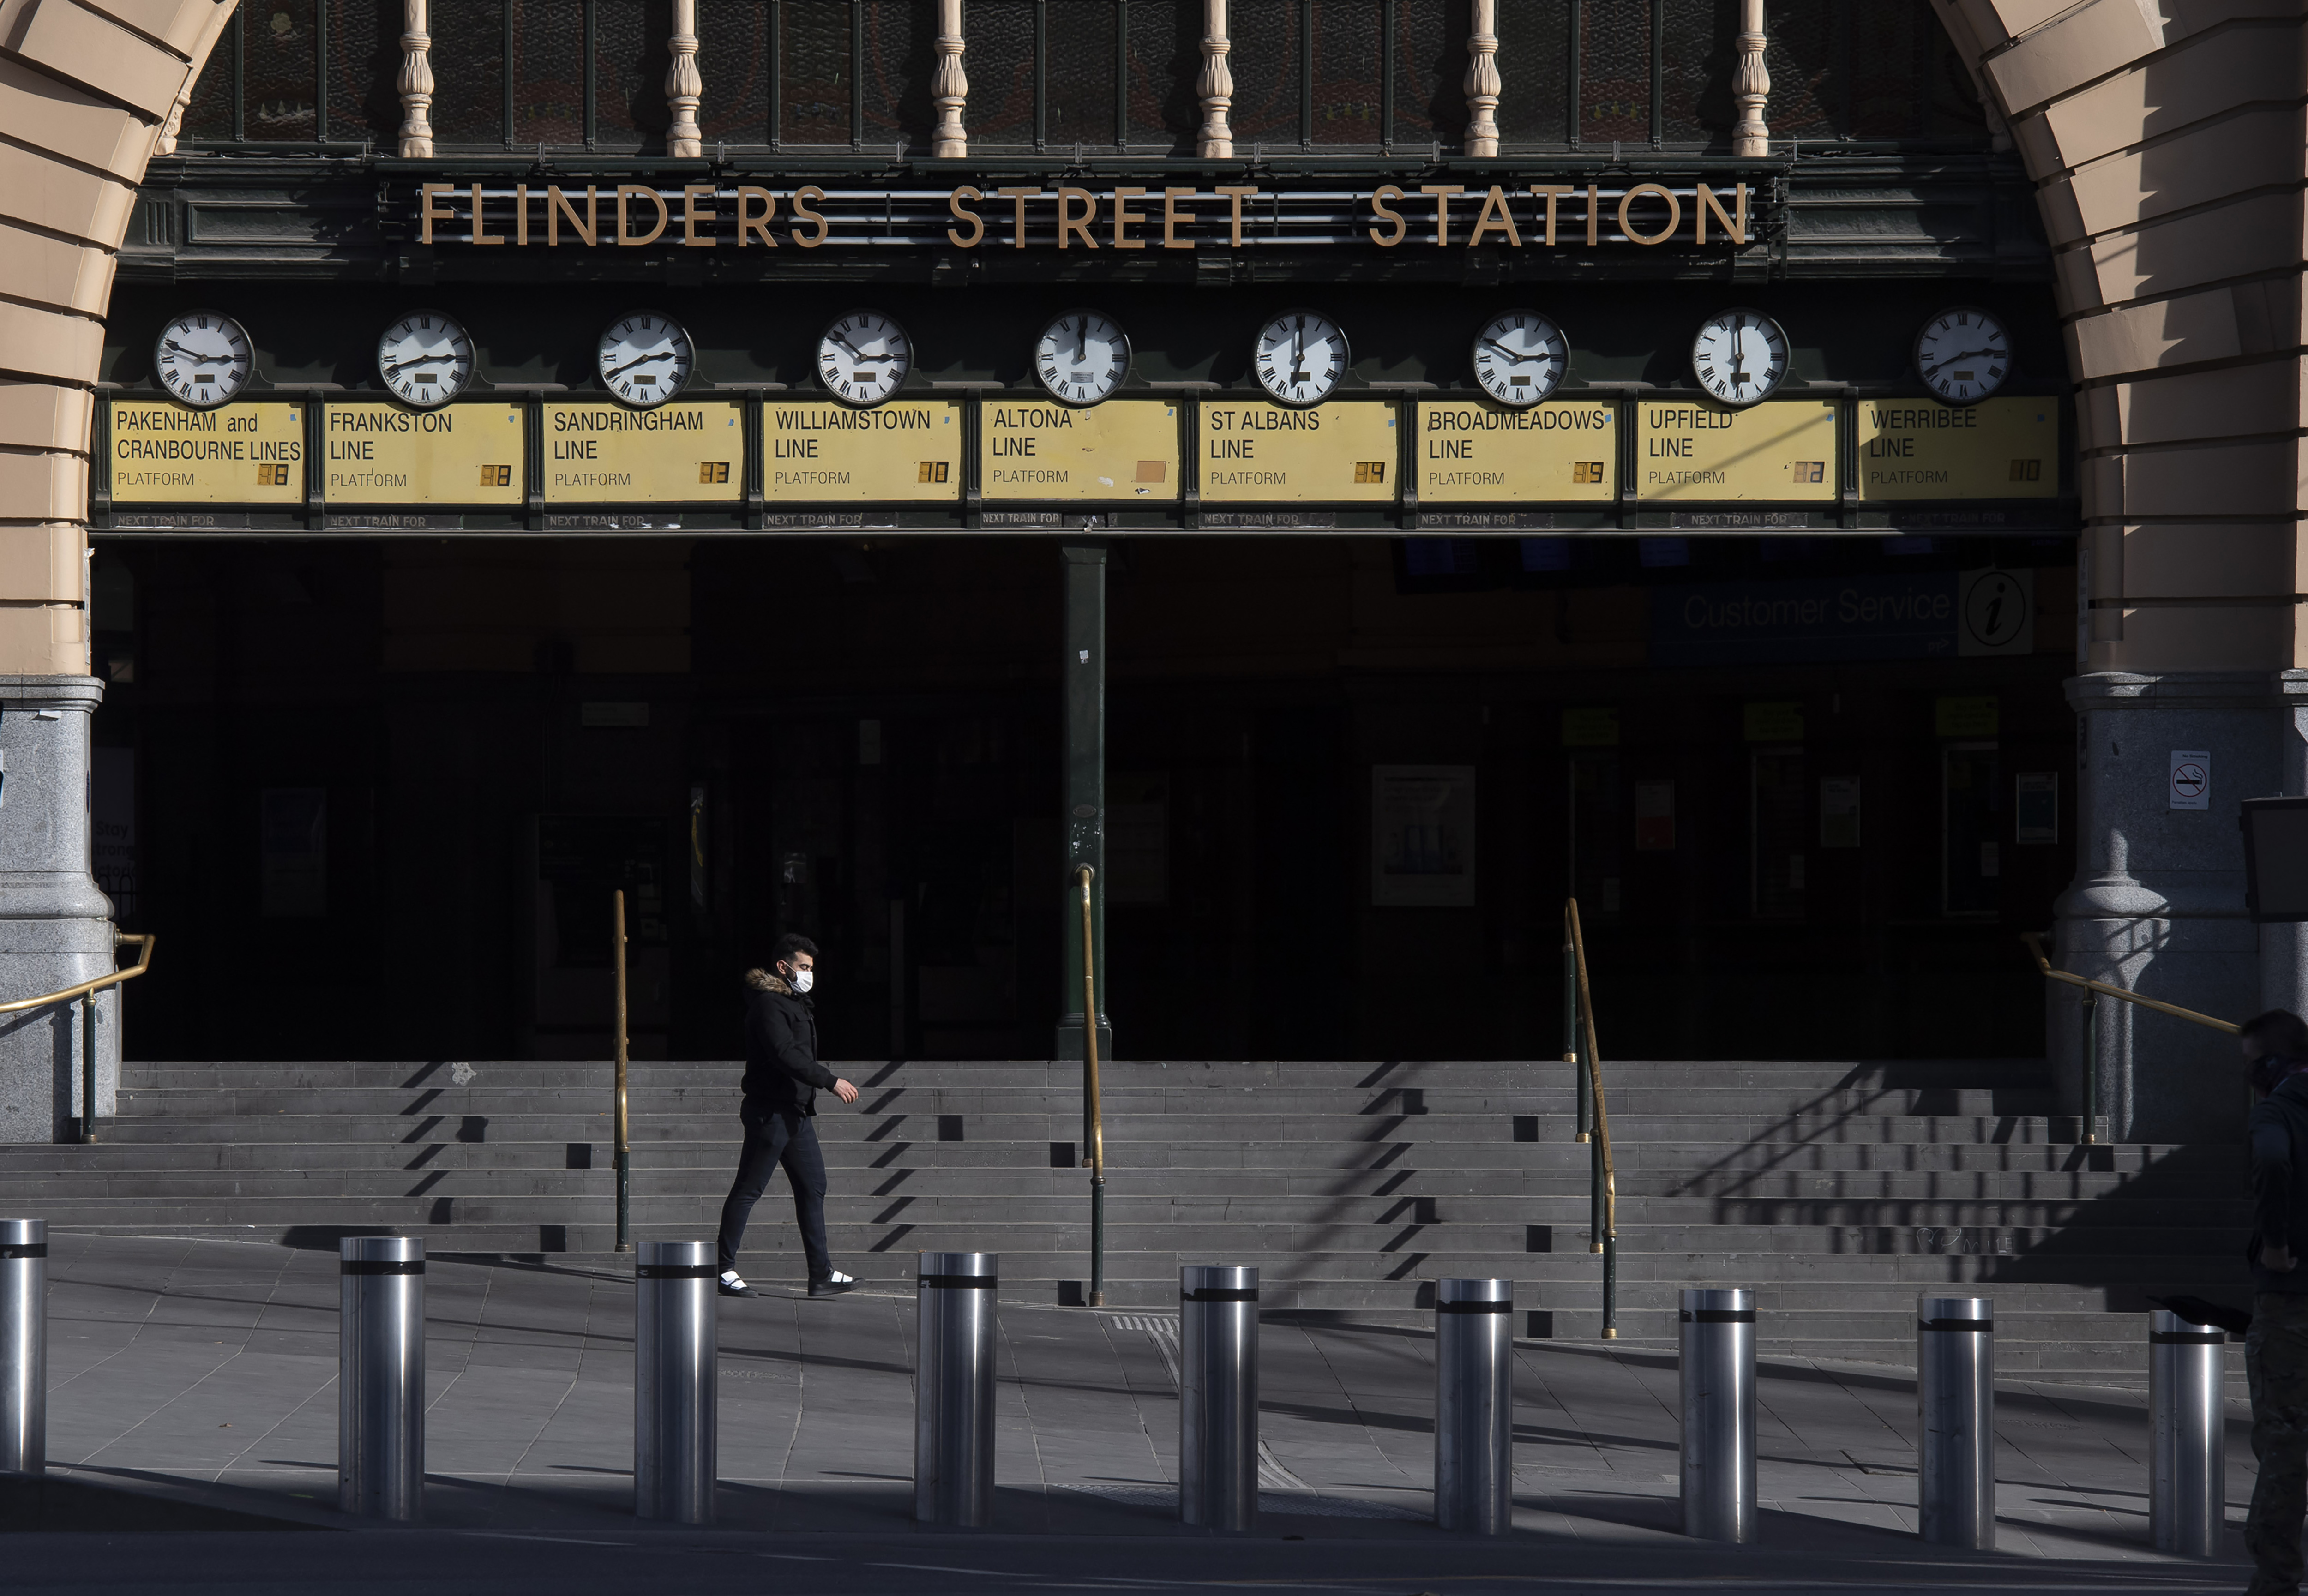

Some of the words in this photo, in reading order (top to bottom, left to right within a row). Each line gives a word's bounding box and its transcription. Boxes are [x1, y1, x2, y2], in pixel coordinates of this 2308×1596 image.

[422, 183, 828, 247] FLINDERS
[948, 185, 1259, 248] STREET
[1369, 182, 1746, 247] STATION
[198, 318, 207, 329] XII
[420, 318, 430, 330] XII
[858, 316, 868, 328] XII
[1514, 317, 1524, 330] XII
[118, 409, 217, 431] PAKENHAM
[228, 413, 257, 432] and
[331, 411, 451, 432] FRANKSTON
[555, 410, 702, 431] SANDRINGHAM
[776, 409, 930, 429] WILLIAMSTOWN
[994, 409, 1072, 428] ALTONA
[1212, 411, 1235, 430] ST
[1241, 411, 1319, 430] ALBANS
[1428, 409, 1604, 432] BROADMEADOWS
[1651, 408, 1734, 428] UPFIELD
[1873, 408, 1977, 428] WERRIBEE
[118, 440, 243, 460] CRANBOURNE
[251, 442, 300, 461] LINES
[331, 441, 373, 459] LINE
[555, 441, 597, 459] LINE
[776, 439, 818, 457] LINE
[993, 438, 1035, 456] LINE
[1212, 440, 1253, 458] LINE
[1430, 440, 1472, 458] LINE
[1650, 438, 1692, 456] LINE
[1871, 438, 1914, 457] LINE
[118, 473, 193, 485] PLATFORM
[331, 472, 406, 486] PLATFORM
[556, 474, 630, 485] PLATFORM
[776, 472, 849, 484] PLATFORM
[994, 470, 1067, 482] PLATFORM
[1212, 472, 1285, 484] PLATFORM
[1430, 472, 1504, 484] PLATFORM
[1650, 471, 1724, 484] PLATFORM
[1872, 471, 1947, 483] PLATFORM
[118, 516, 148, 527] NEXT
[152, 516, 185, 527] TRAIN
[190, 516, 214, 527] FOR
[331, 516, 360, 527] NEXT
[364, 516, 397, 527] TRAIN
[402, 516, 425, 527] FOR
[550, 516, 579, 527] NEXT
[583, 516, 617, 527] TRAIN
[622, 516, 644, 527] FOR
[767, 515, 797, 526] NEXT
[800, 515, 834, 526] TRAIN
[839, 515, 861, 526] FOR
[983, 513, 1005, 523] NEXT
[1008, 513, 1036, 523] TRAIN
[1040, 513, 1059, 523] FOR
[1205, 514, 1234, 524] NEXT
[1238, 514, 1271, 524] TRAIN
[1276, 514, 1298, 524] FOR
[1422, 515, 1451, 526] NEXT
[1455, 515, 1489, 526] TRAIN
[1494, 515, 1515, 526] FOR
[1691, 514, 1721, 525] NEXT
[1725, 514, 1760, 525] TRAIN
[1765, 514, 1786, 525] FOR
[1909, 513, 1939, 523] NEXT
[1944, 513, 1977, 523] TRAIN
[1983, 513, 2005, 523] FOR
[1684, 595, 1830, 629] Customer
[1839, 588, 1951, 623] Service
